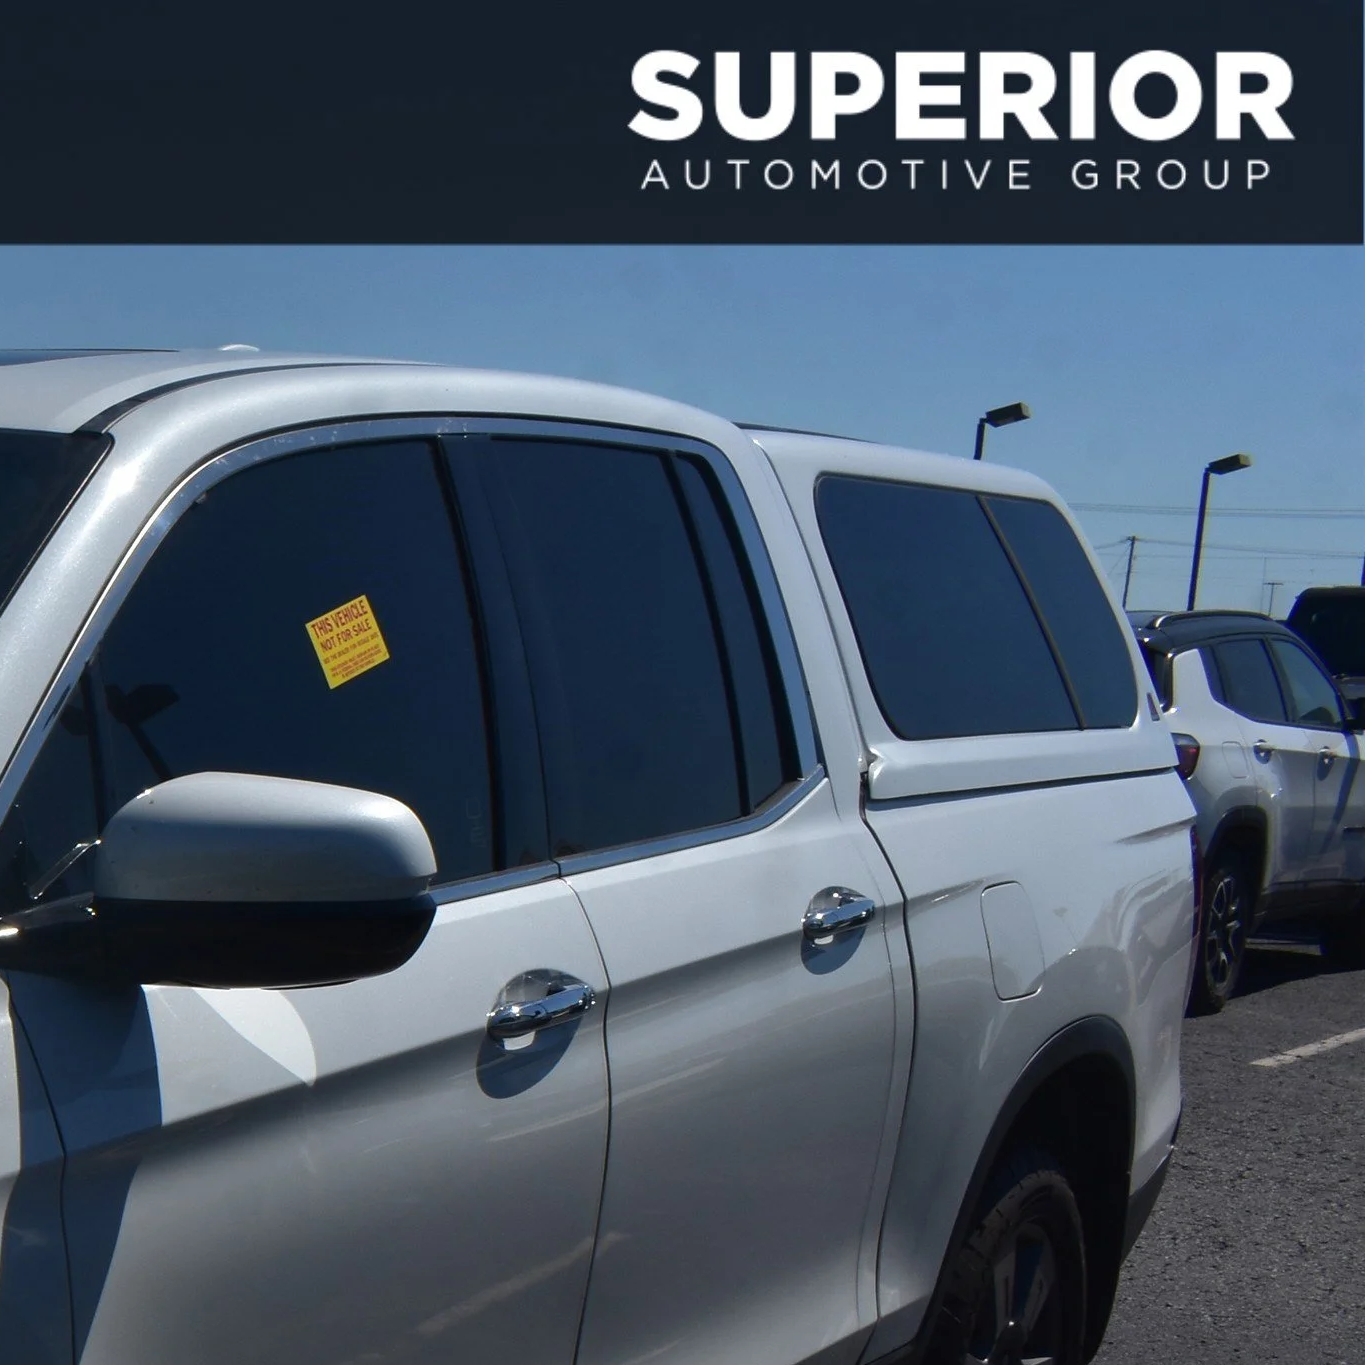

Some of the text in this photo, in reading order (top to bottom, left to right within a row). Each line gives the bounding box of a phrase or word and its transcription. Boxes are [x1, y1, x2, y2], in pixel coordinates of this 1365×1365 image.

[311, 600, 369, 639] THIS VEHICLE
[320, 636, 337, 652] NOT
[336, 628, 354, 645] FOR
[351, 618, 372, 637] SALE
